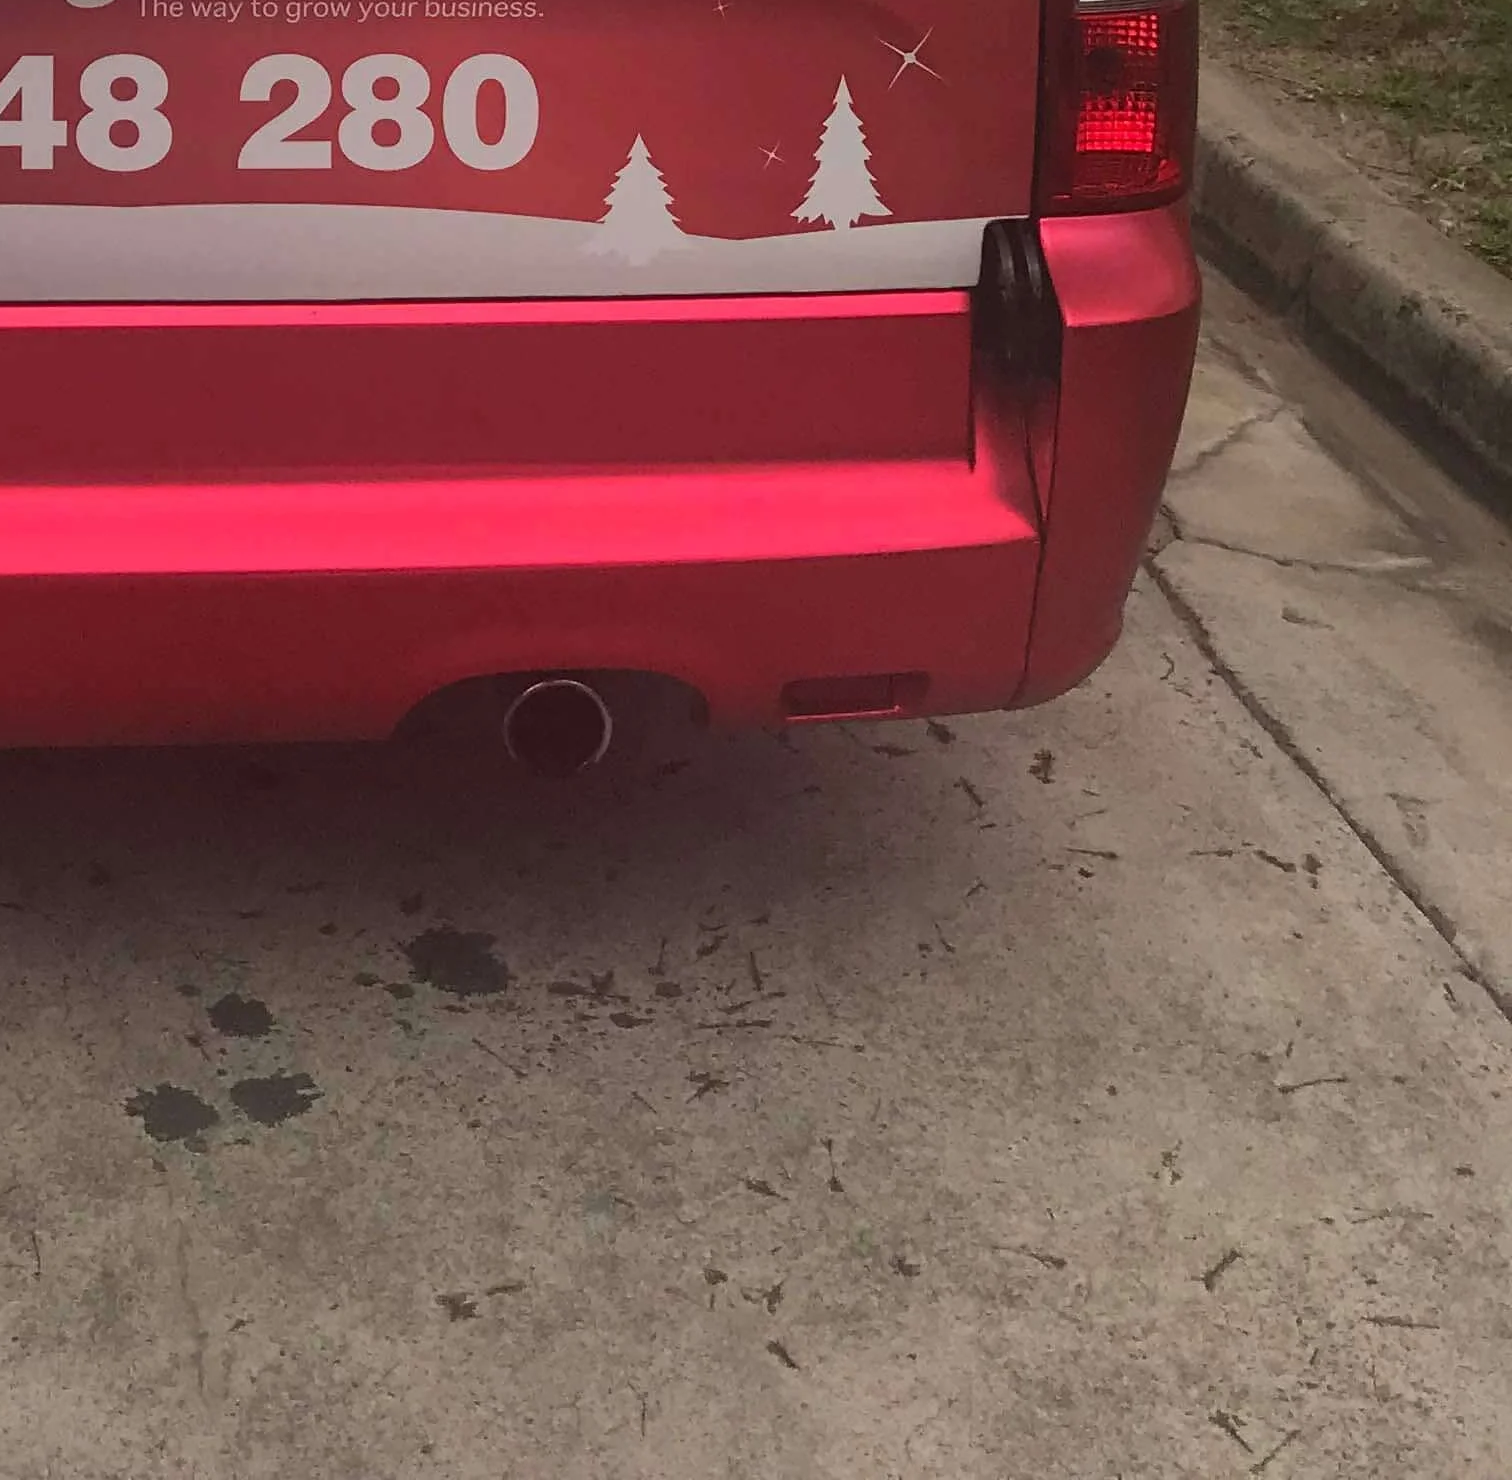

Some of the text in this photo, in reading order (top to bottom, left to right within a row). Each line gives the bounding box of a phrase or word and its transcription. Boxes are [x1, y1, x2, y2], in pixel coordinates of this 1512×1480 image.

[192, 1, 244, 23] way
[286, 1, 352, 24] grow
[358, 1, 419, 23] your
[238, 53, 540, 172] 280
